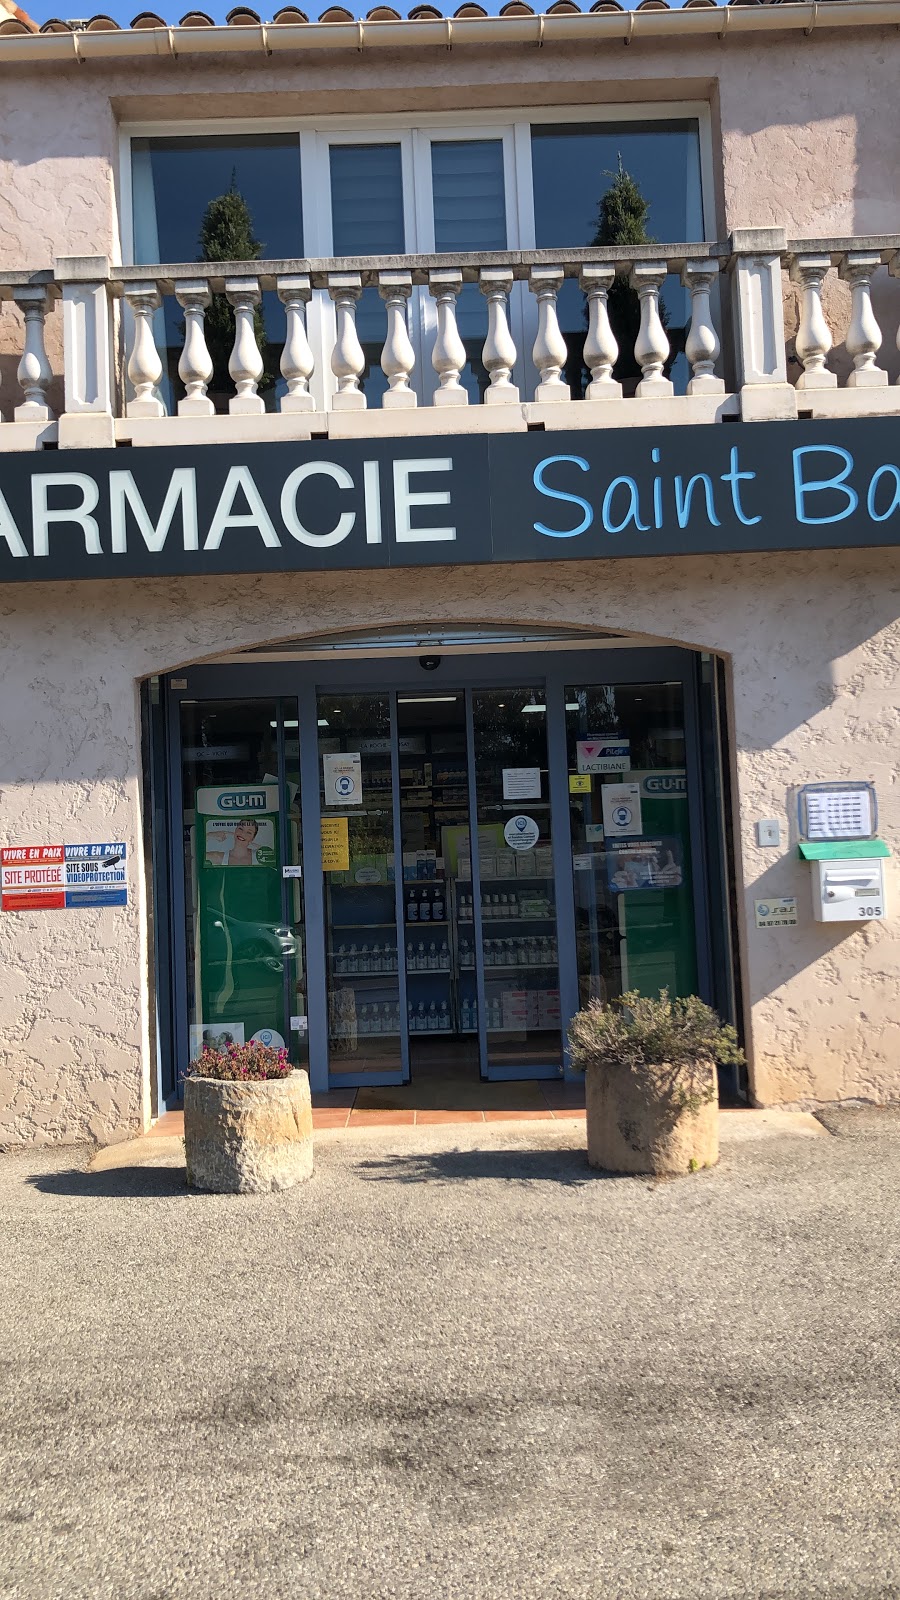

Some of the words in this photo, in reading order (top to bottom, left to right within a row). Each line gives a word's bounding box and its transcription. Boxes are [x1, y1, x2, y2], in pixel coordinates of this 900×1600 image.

[532, 445, 763, 538] Saint
[792, 444, 900, 525] Ba
[582, 762, 626, 772] LACTIBIANE
[3, 849, 26, 860] VIVRE
[29, 848, 40, 859] EN
[42, 848, 62, 858] PAIX
[65, 846, 88, 857] VIVRE
[91, 846, 102, 856] EN
[104, 844, 124, 855] PAIX
[66, 863, 80, 873] SITE
[81, 862, 99, 872] SOUS
[4, 870, 22, 884] SITE
[24, 866, 62, 884] PROTÉGÉ
[66, 871, 125, 883] VIDEOPROTECTION
[858, 906, 882, 916] 305
